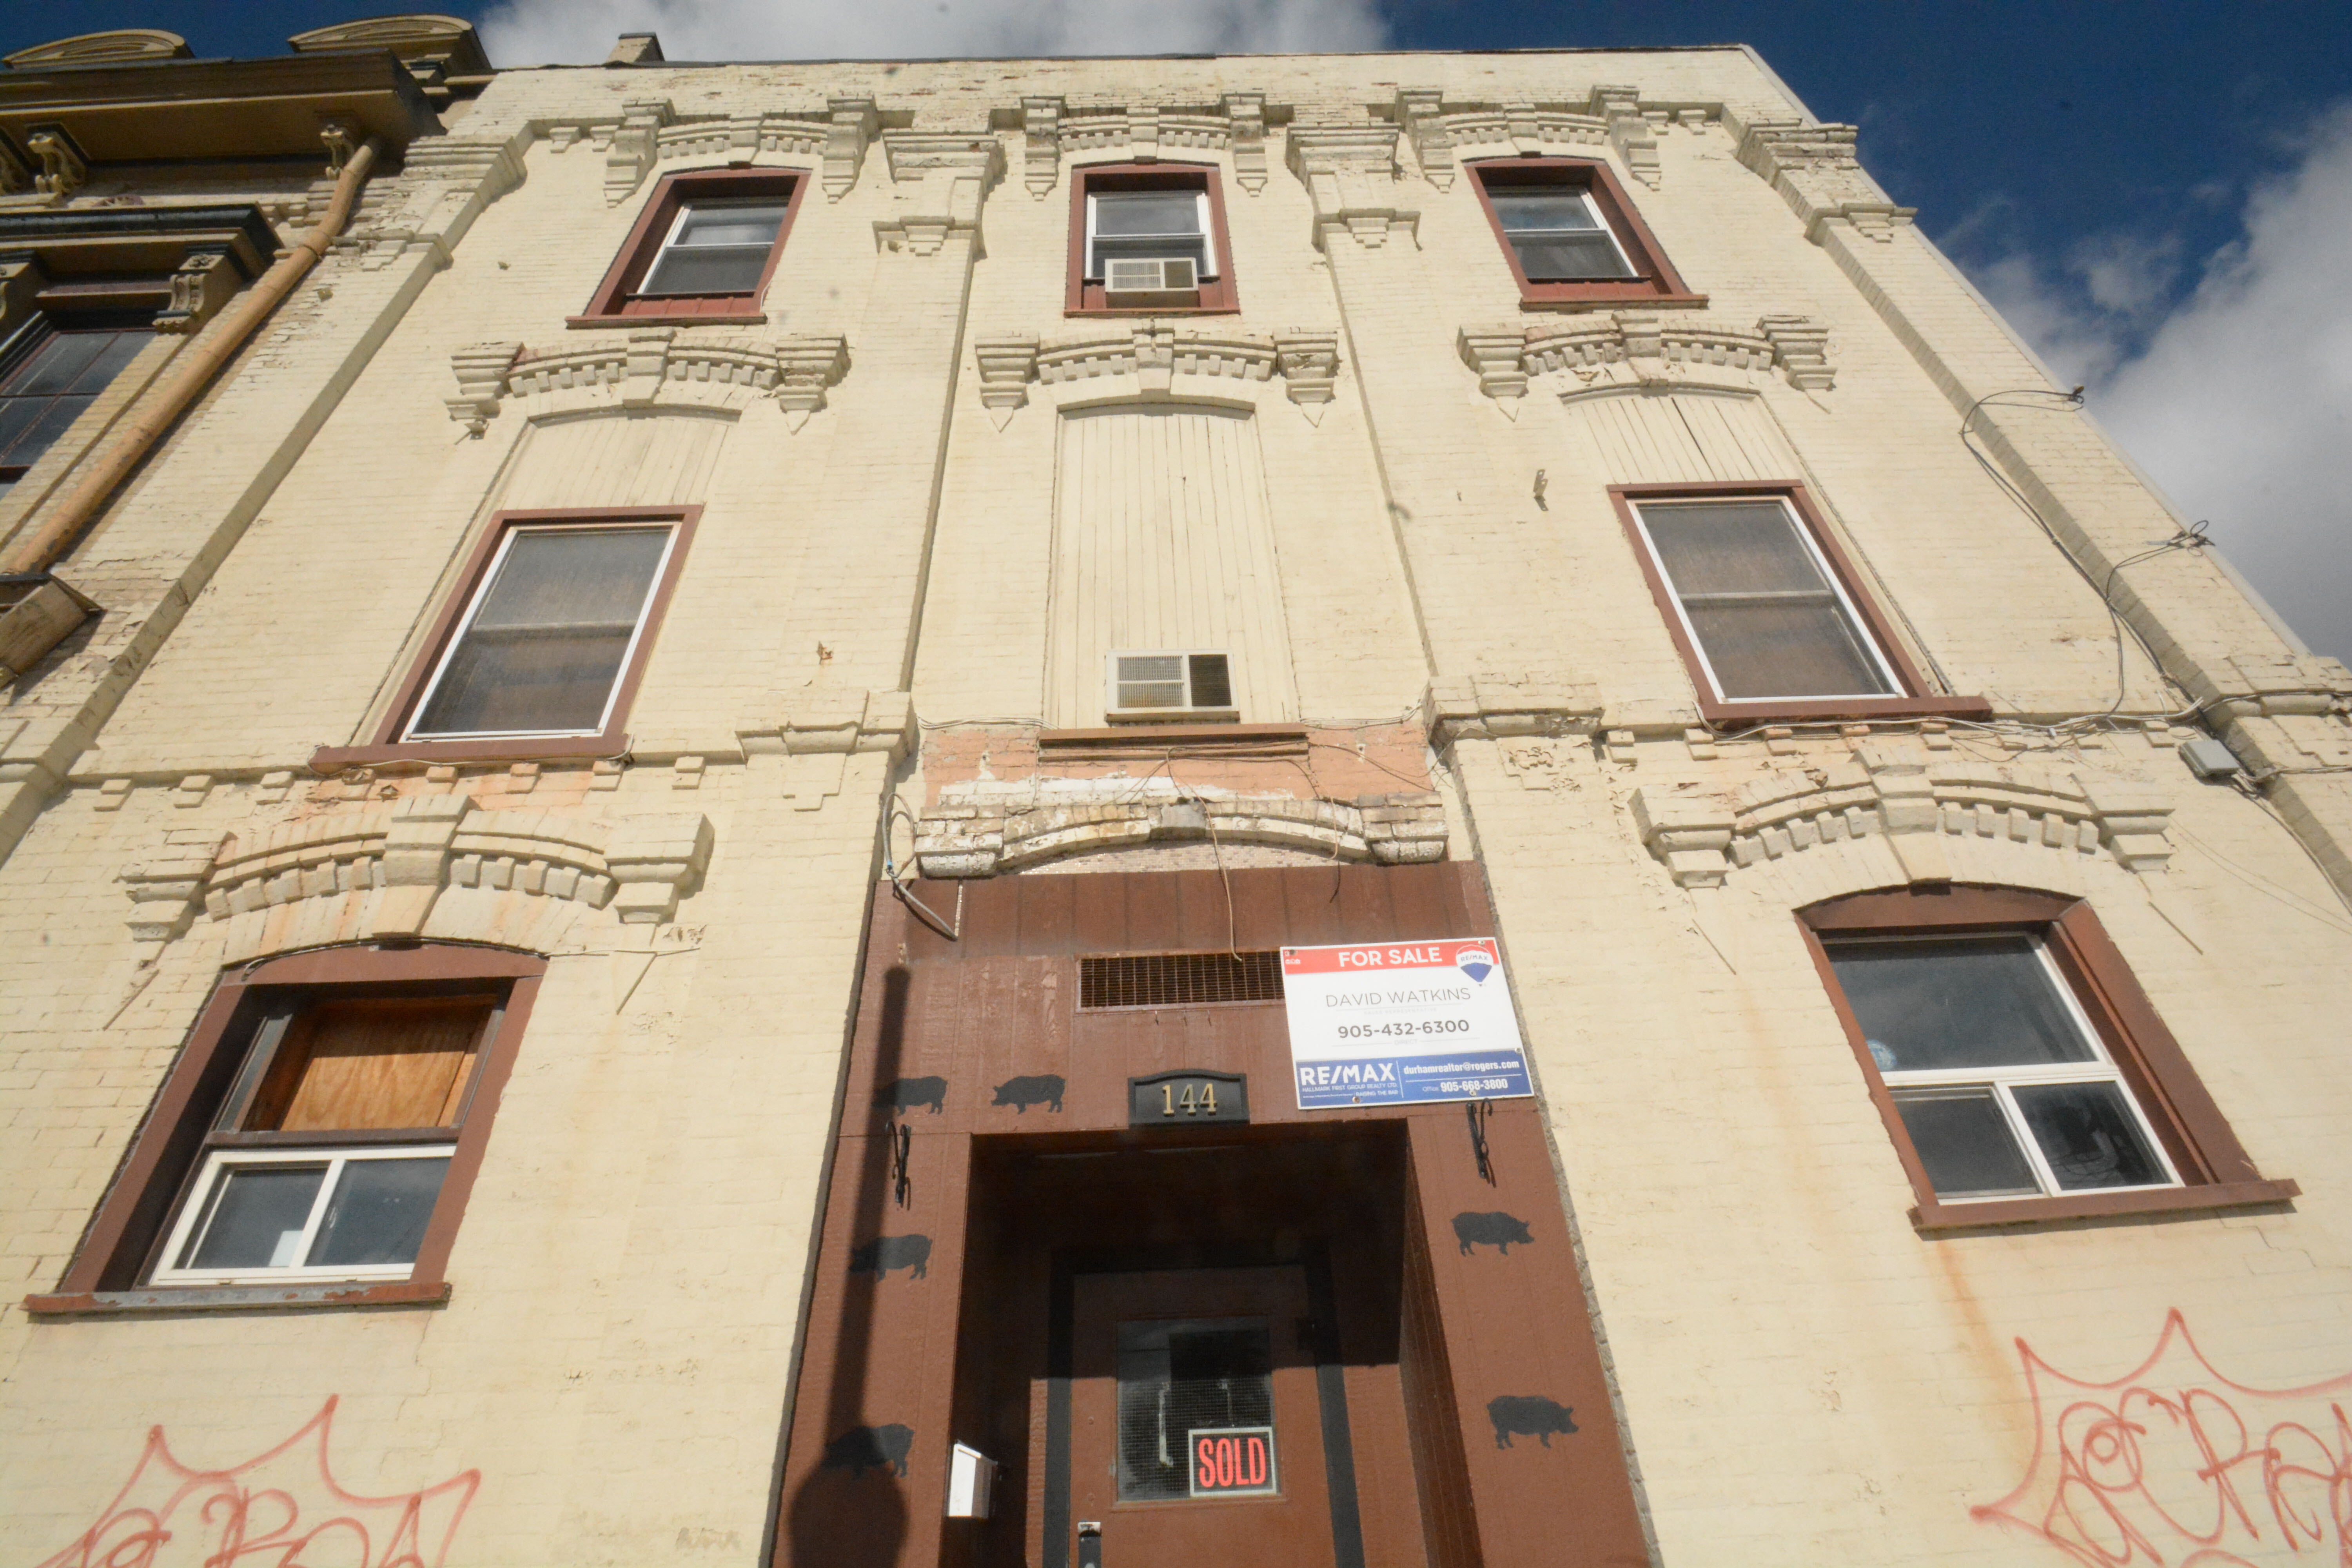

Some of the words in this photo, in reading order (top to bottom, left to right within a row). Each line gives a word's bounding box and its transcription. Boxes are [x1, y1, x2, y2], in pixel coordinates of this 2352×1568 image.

[1338, 952, 1383, 967] FOR
[1389, 947, 1443, 964] SALE
[1326, 993, 1382, 1007] DAVID
[1387, 987, 1471, 1004] WATKINS
[1338, 1019, 1470, 1038] 905-432-6300
[1300, 1063, 1396, 1085] RE/MAX
[1404, 1061, 1520, 1074] durhamrealtor@rogers.com
[1440, 1078, 1508, 1092] 905-668-3800
[1162, 1083, 1217, 1116] 144
[1198, 1437, 1267, 1488] SOLD
